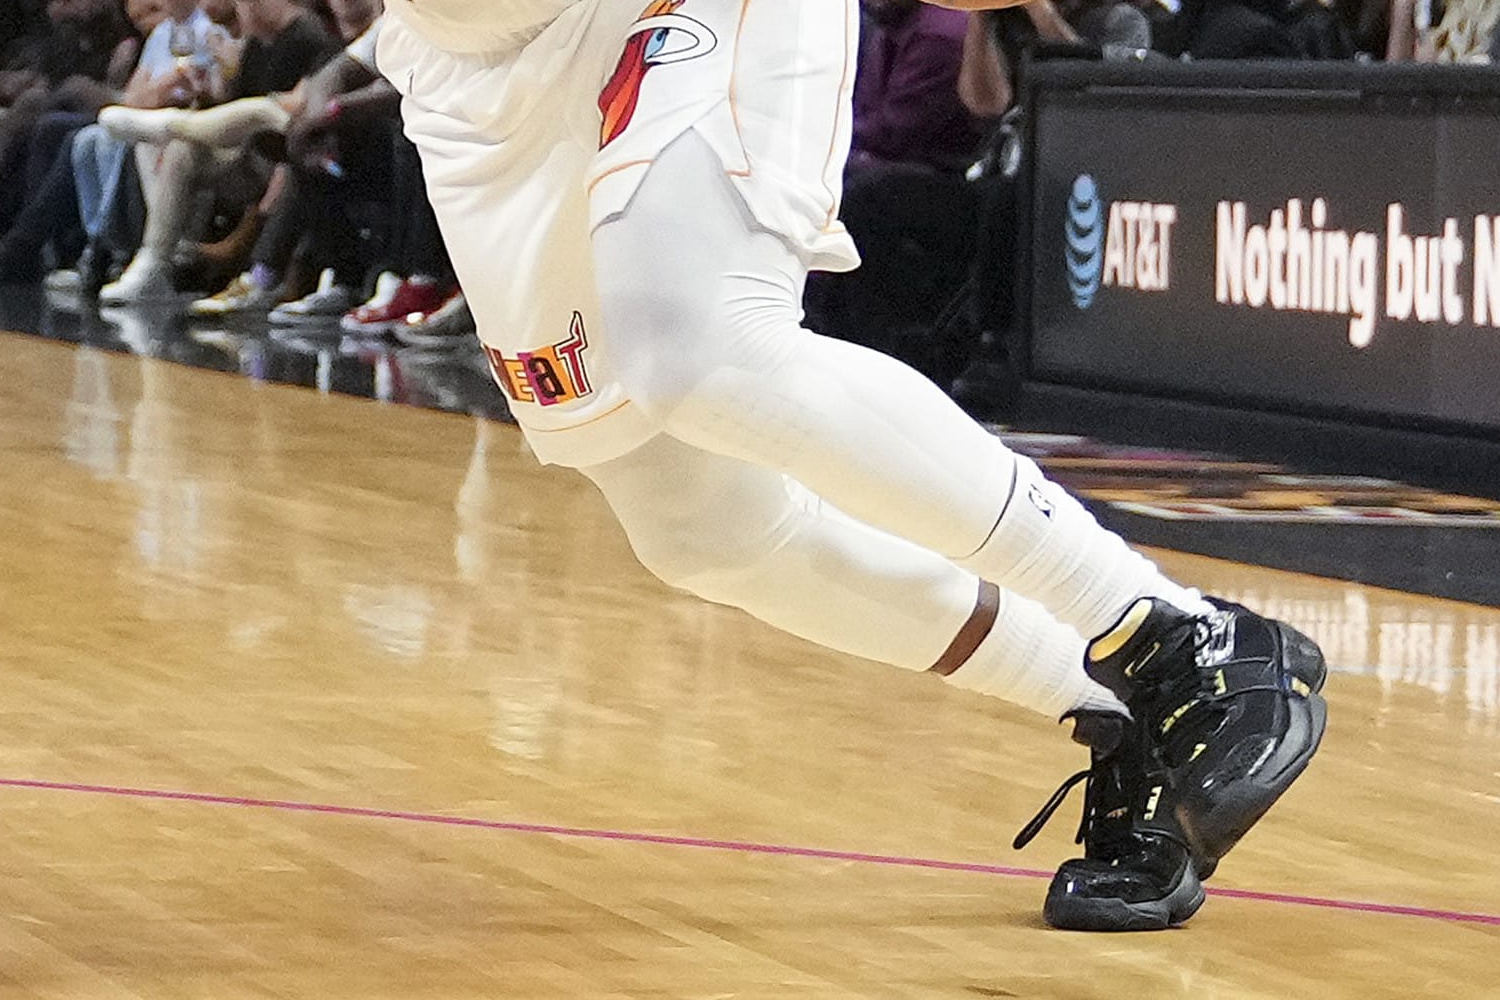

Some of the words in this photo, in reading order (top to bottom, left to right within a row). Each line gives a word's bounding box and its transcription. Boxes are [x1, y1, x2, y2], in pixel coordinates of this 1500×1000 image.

[1102, 200, 1177, 291] AT&T
[1215, 197, 1378, 348] Nothing
[1385, 201, 1464, 325] but
